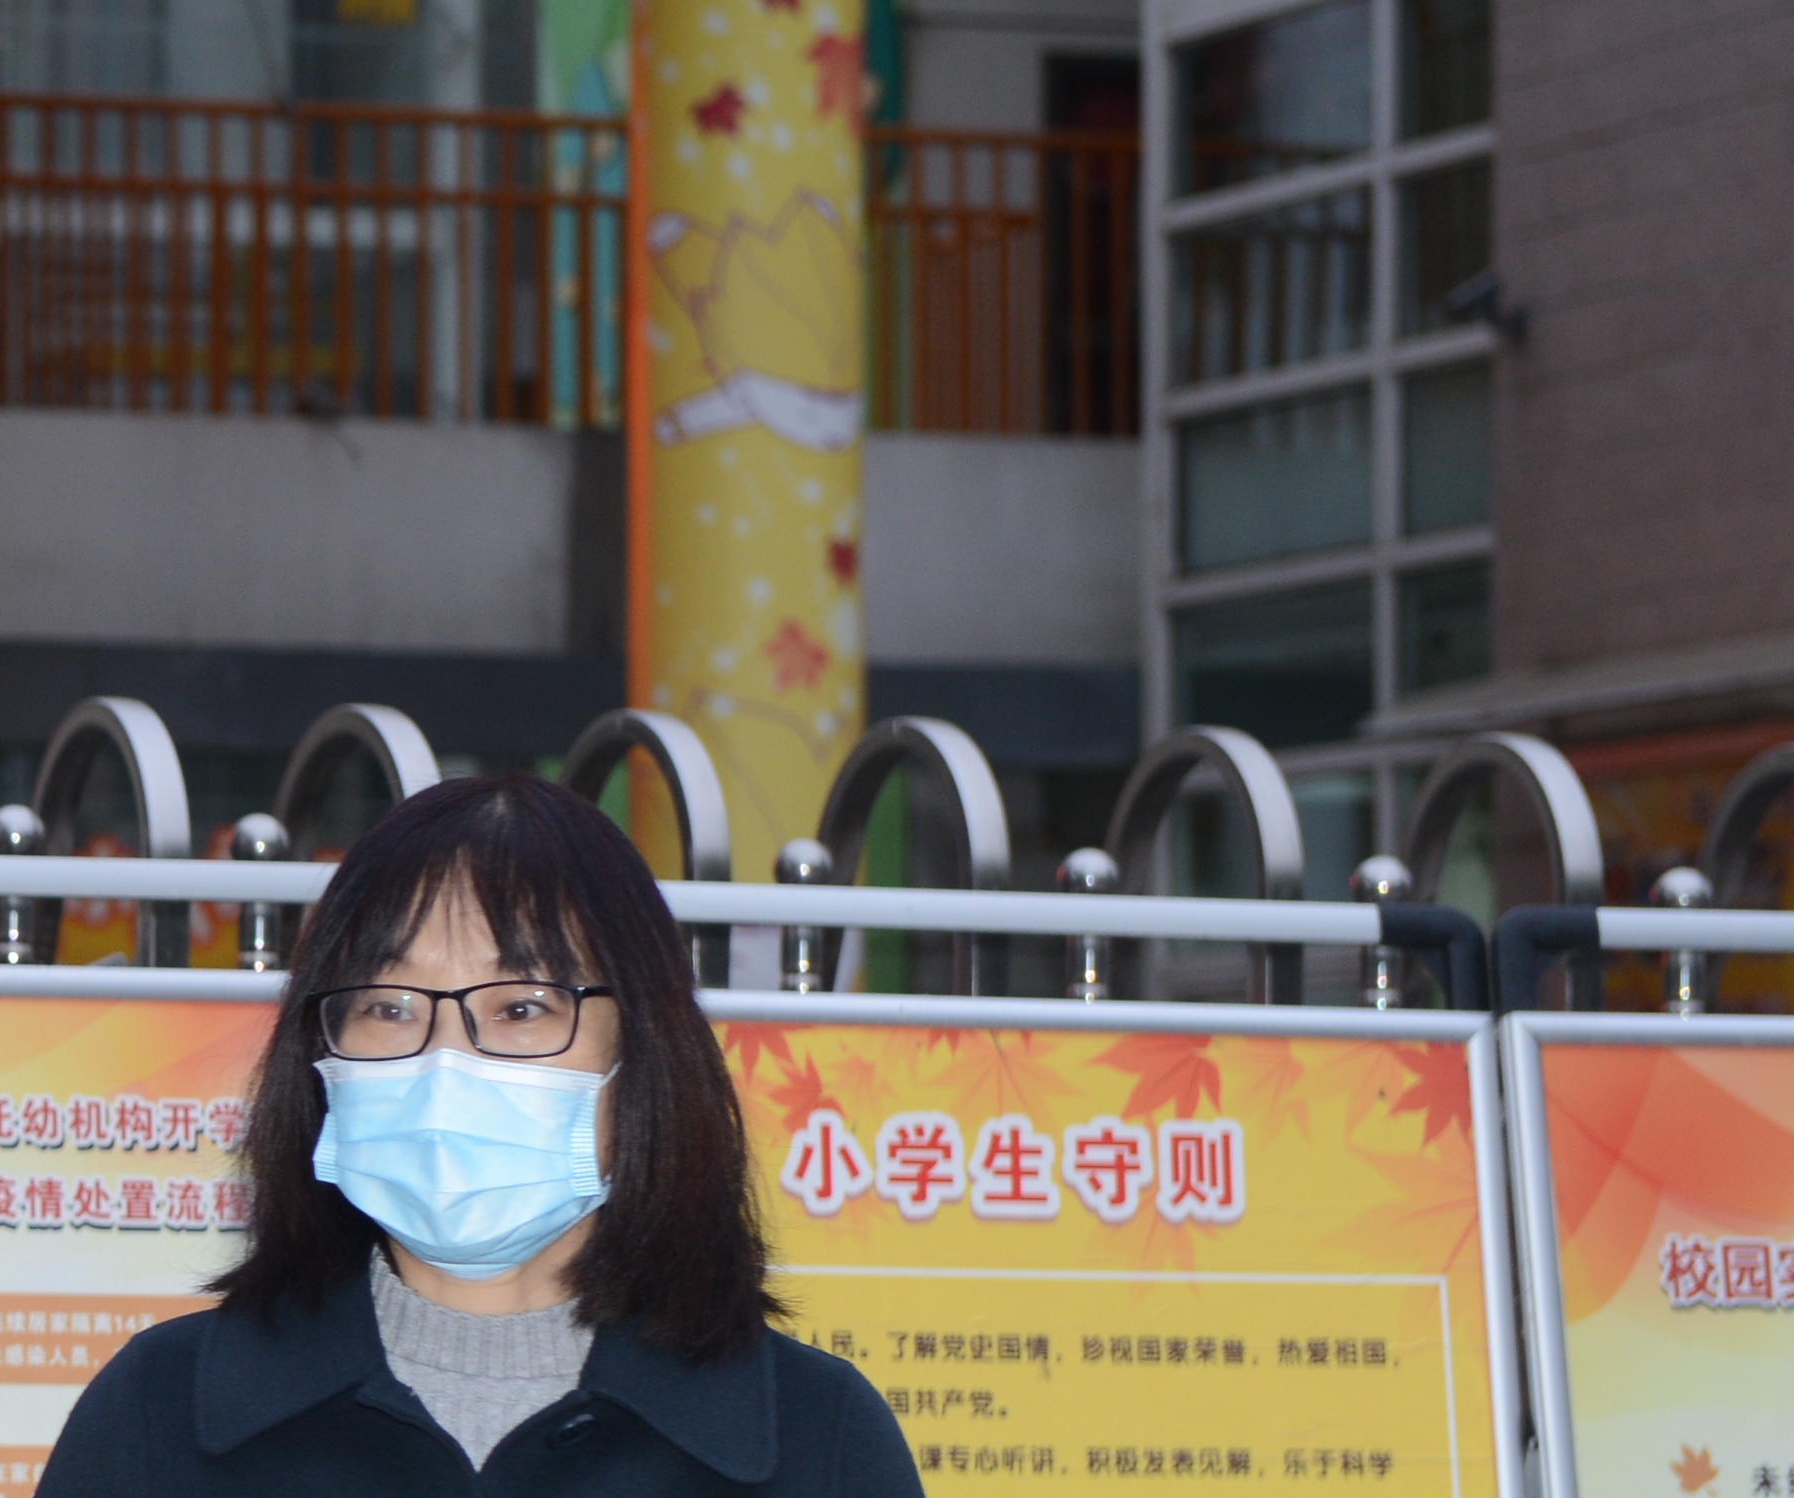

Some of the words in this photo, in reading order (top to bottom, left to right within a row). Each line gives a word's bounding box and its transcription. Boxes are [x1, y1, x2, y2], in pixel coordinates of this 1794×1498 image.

[789, 1118, 1238, 1214] 小学生守则
